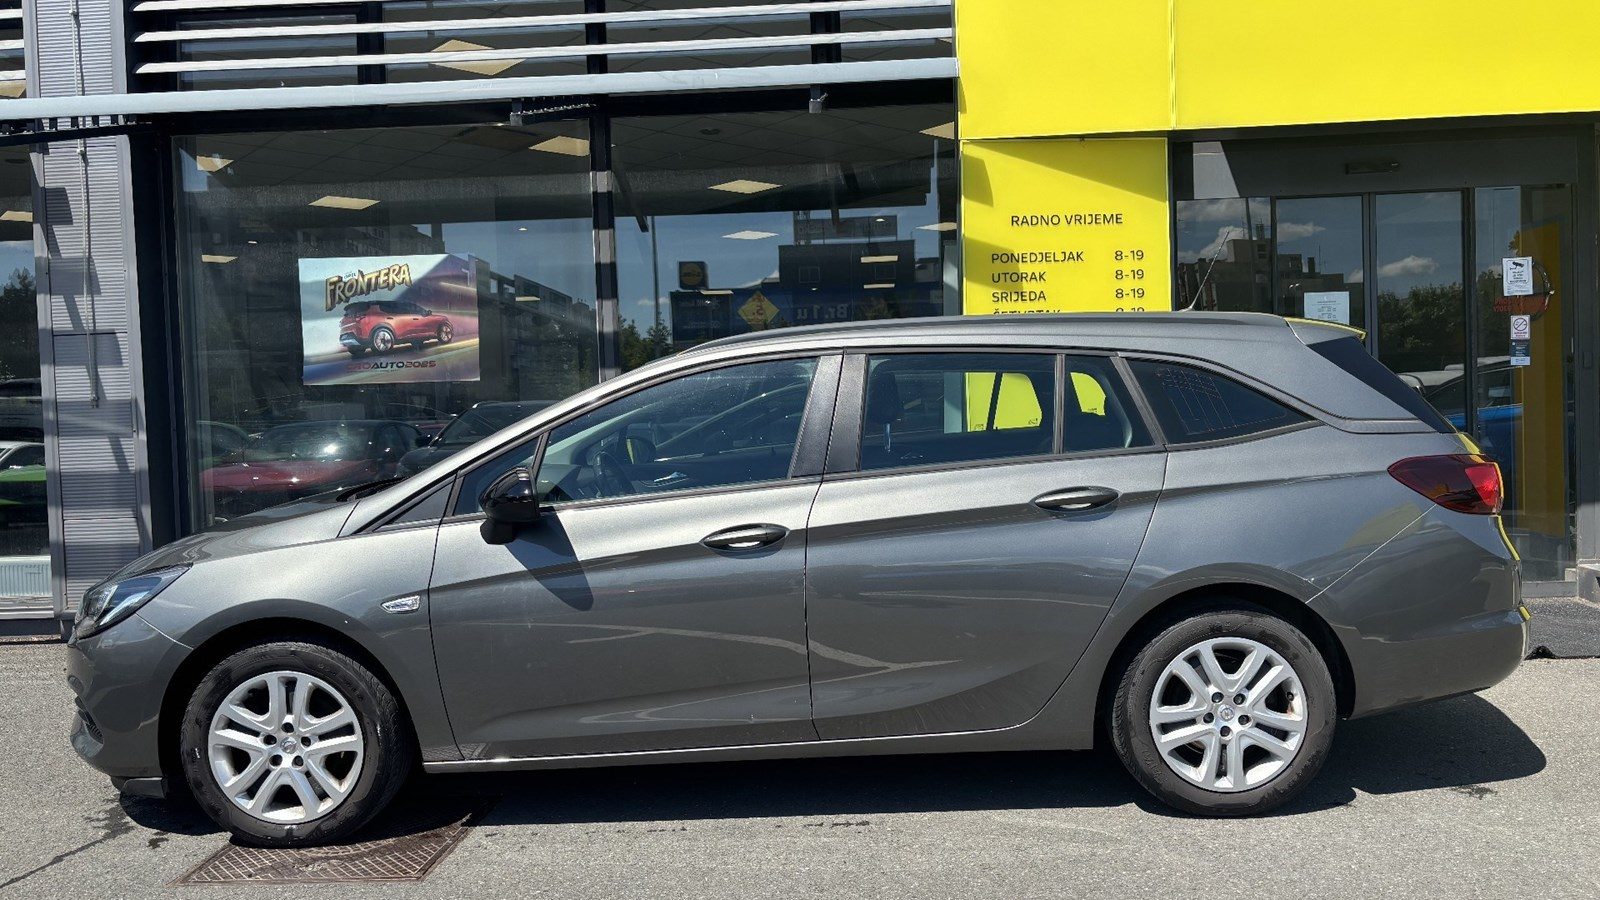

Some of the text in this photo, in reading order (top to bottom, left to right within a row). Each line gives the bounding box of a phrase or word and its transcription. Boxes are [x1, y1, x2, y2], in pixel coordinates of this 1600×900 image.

[1011, 213, 1123, 226] RADNO VRIJEME
[991, 250, 1144, 263] PONEDJELJAK 8-19
[991, 269, 1145, 283] UTORAK 8-19
[325, 263, 413, 312] FRONTERA
[992, 288, 1145, 302] SRIJEDA 8-19
